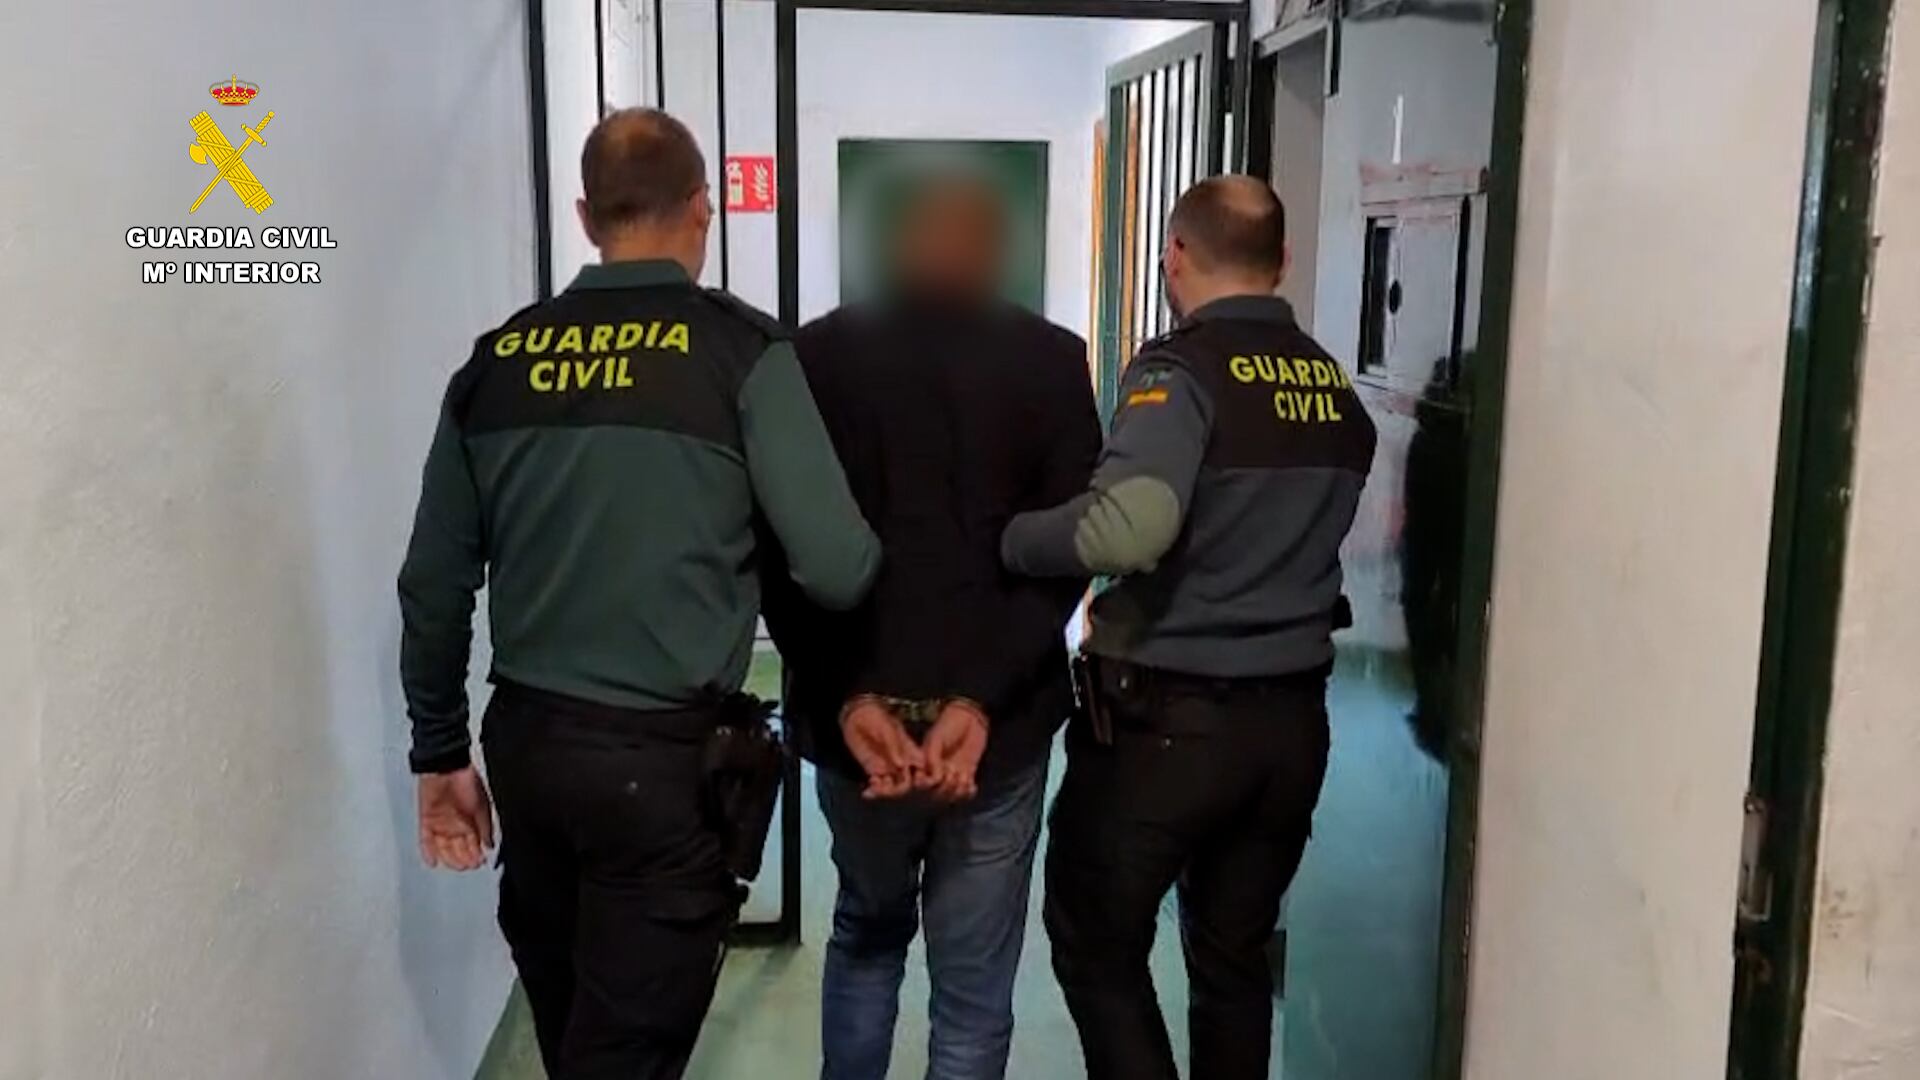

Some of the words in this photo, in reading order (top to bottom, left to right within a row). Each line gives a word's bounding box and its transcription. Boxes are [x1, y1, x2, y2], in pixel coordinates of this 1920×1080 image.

[494, 321, 690, 357] GUARDIA
[529, 357, 634, 392] CIVIL
[1274, 390, 1341, 422] CIVIL
